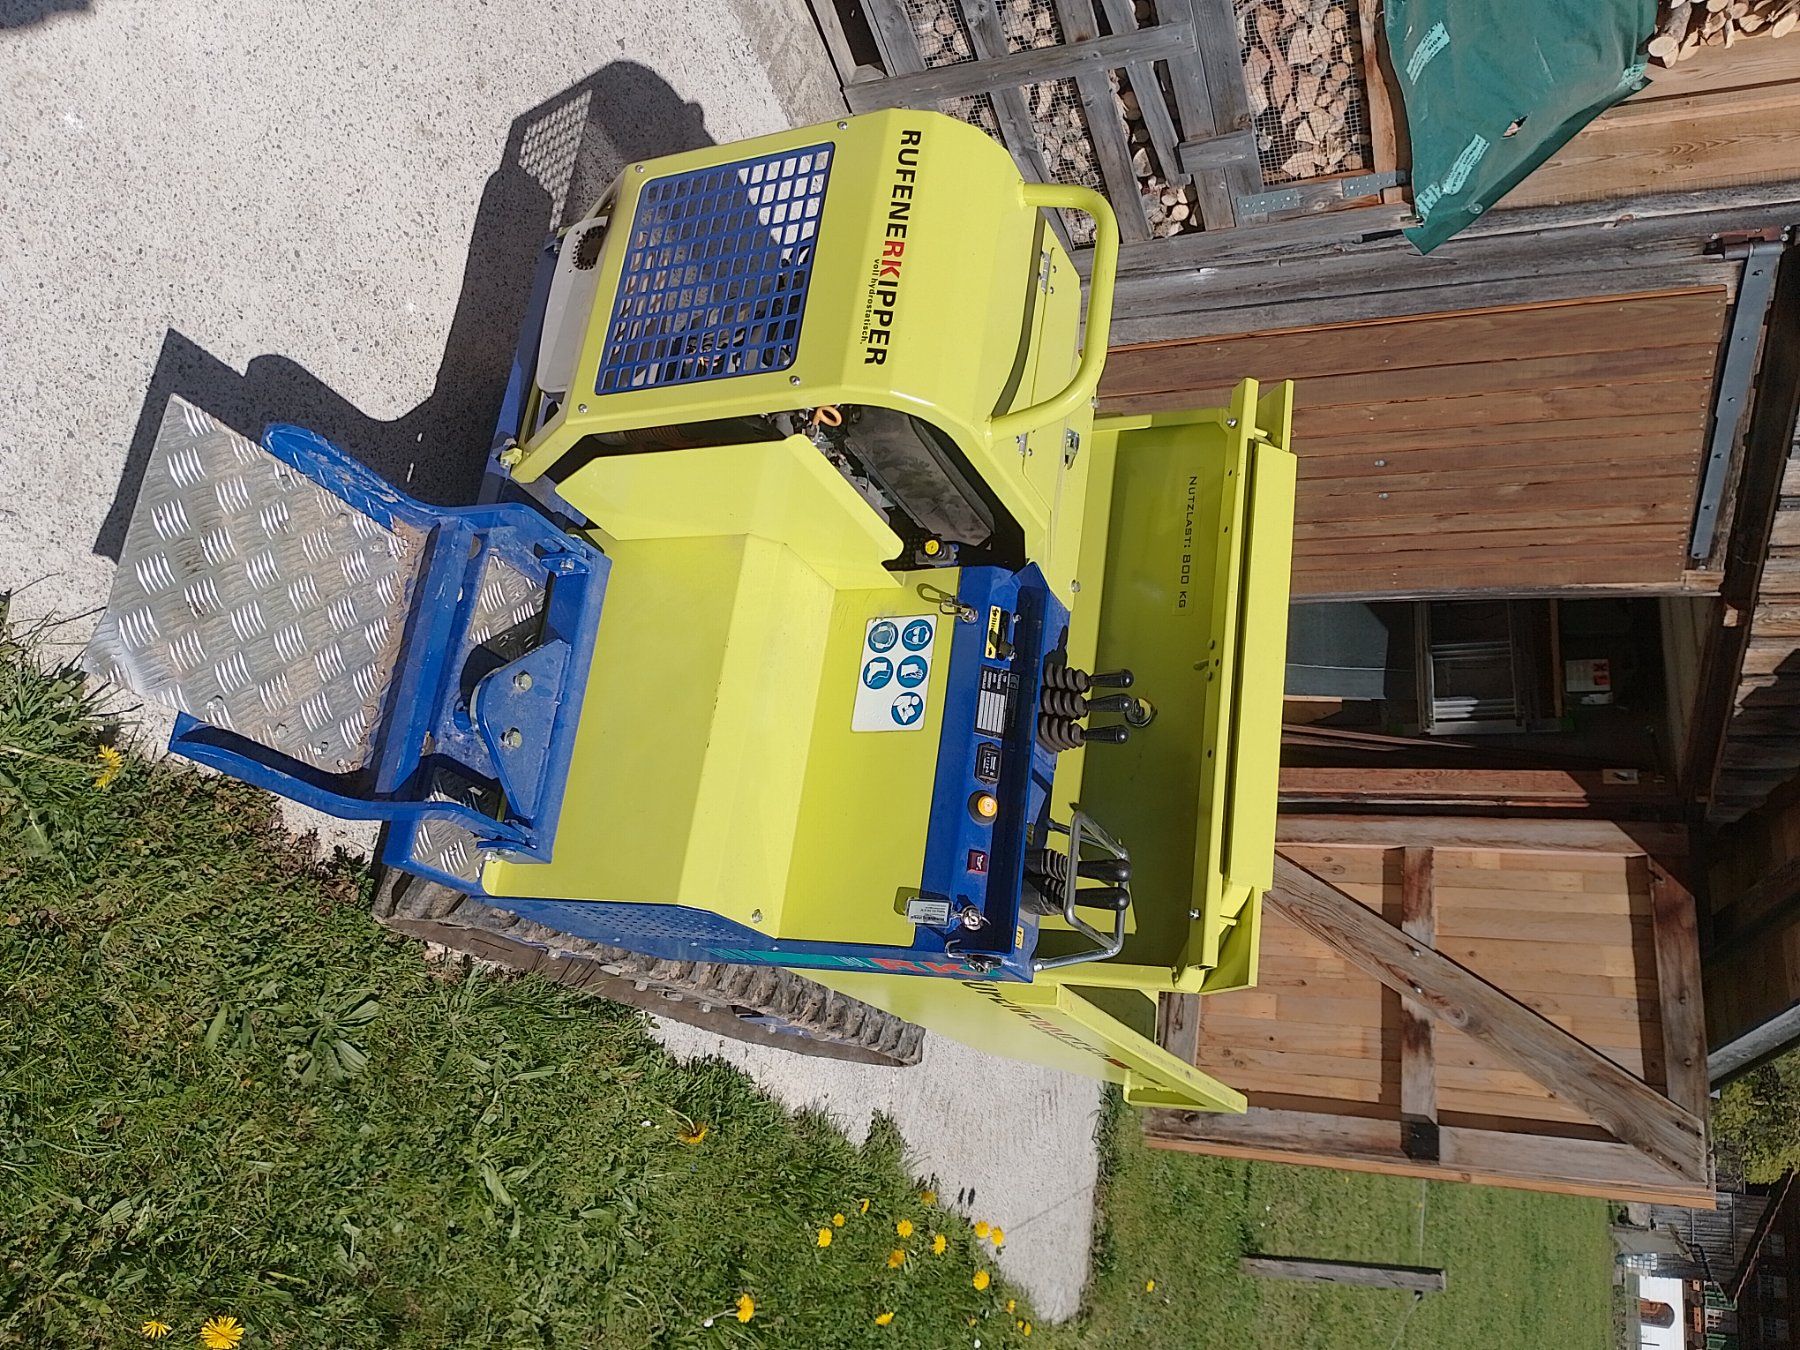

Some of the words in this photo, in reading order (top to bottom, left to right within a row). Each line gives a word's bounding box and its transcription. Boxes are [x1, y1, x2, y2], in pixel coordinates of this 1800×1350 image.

[864, 130, 922, 365] RUFENERKIPPER
[871, 258, 880, 276] voll
[860, 278, 878, 344] hydrostatisch.
[1184, 476, 1197, 548] NUTZLAST:
[1180, 554, 1191, 584] 800
[1178, 590, 1187, 608] KG
